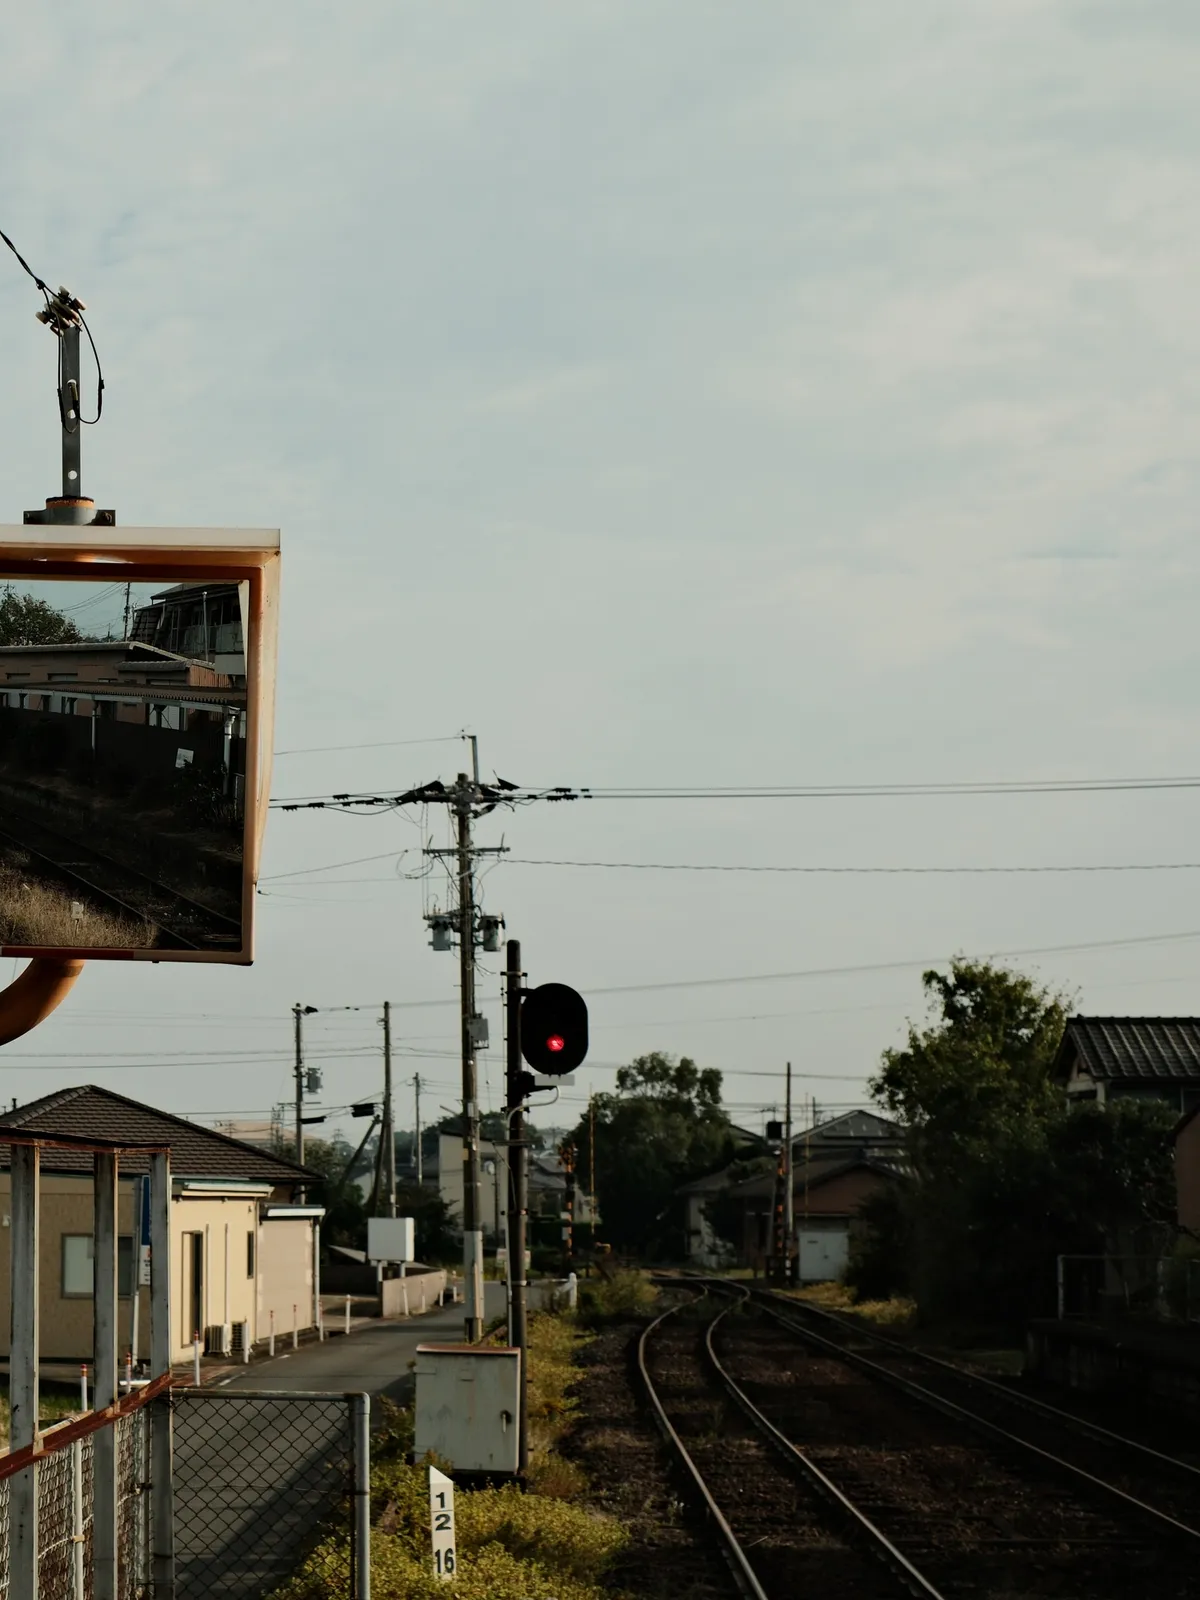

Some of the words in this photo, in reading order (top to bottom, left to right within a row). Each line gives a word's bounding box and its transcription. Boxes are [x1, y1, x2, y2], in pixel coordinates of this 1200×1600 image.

[435, 1492, 445, 1508] 1
[435, 1513, 452, 1531] 2
[435, 1548, 454, 1574] 16
